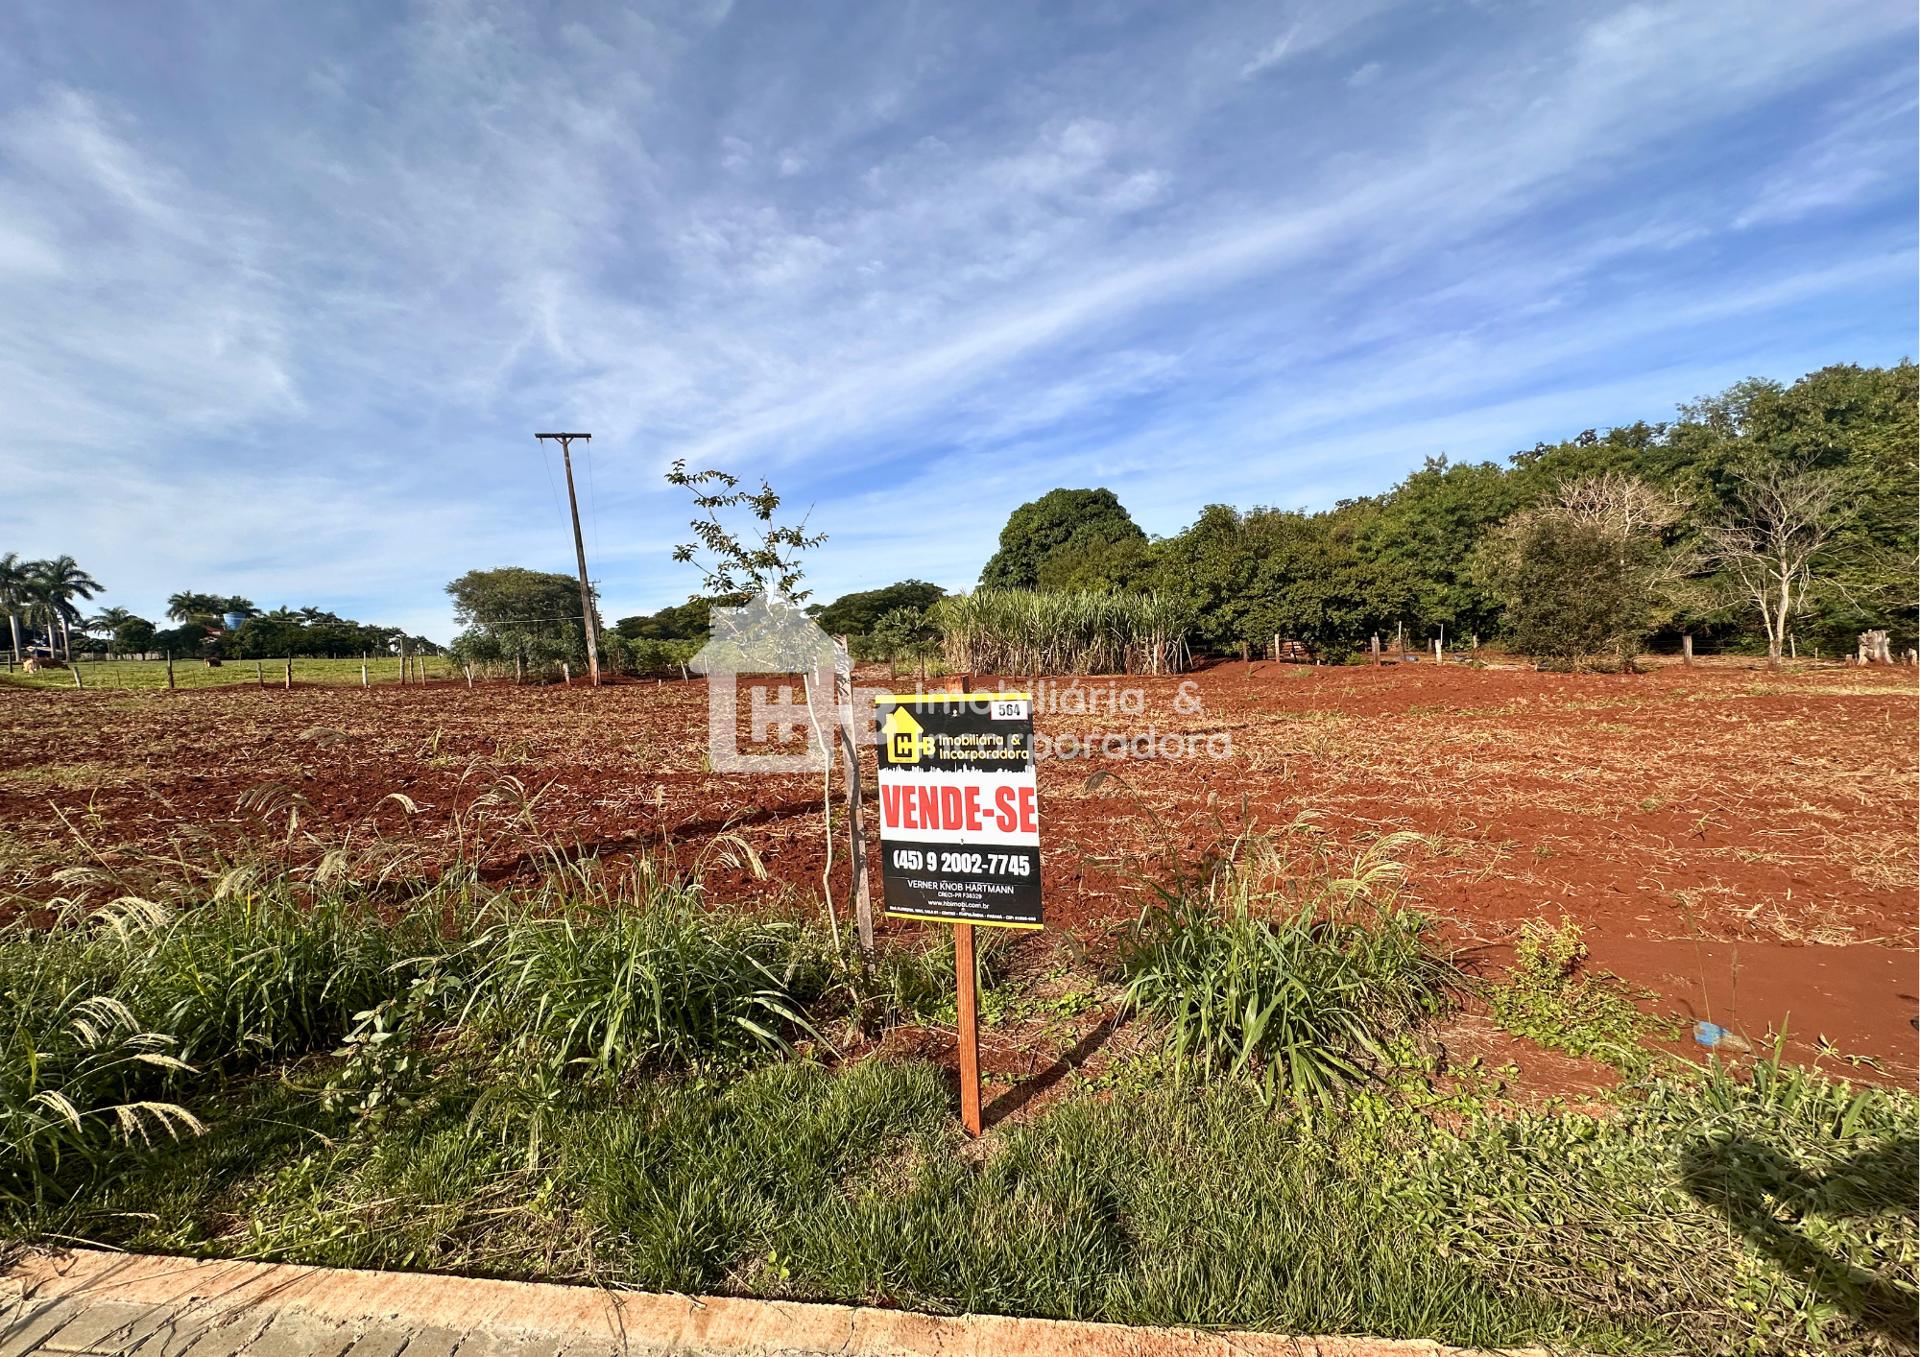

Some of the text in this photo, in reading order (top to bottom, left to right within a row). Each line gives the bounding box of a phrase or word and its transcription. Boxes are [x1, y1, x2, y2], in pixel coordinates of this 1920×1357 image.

[999, 704, 1020, 716] 564
[939, 733, 1021, 746] Imobiliária &
[940, 748, 1030, 761] Incorporadora
[881, 785, 1037, 832] VENDE-SE
[893, 850, 1030, 876] (45) 9 2002-7745
[907, 879, 1014, 894] VERNER KNOB HARTMANN
